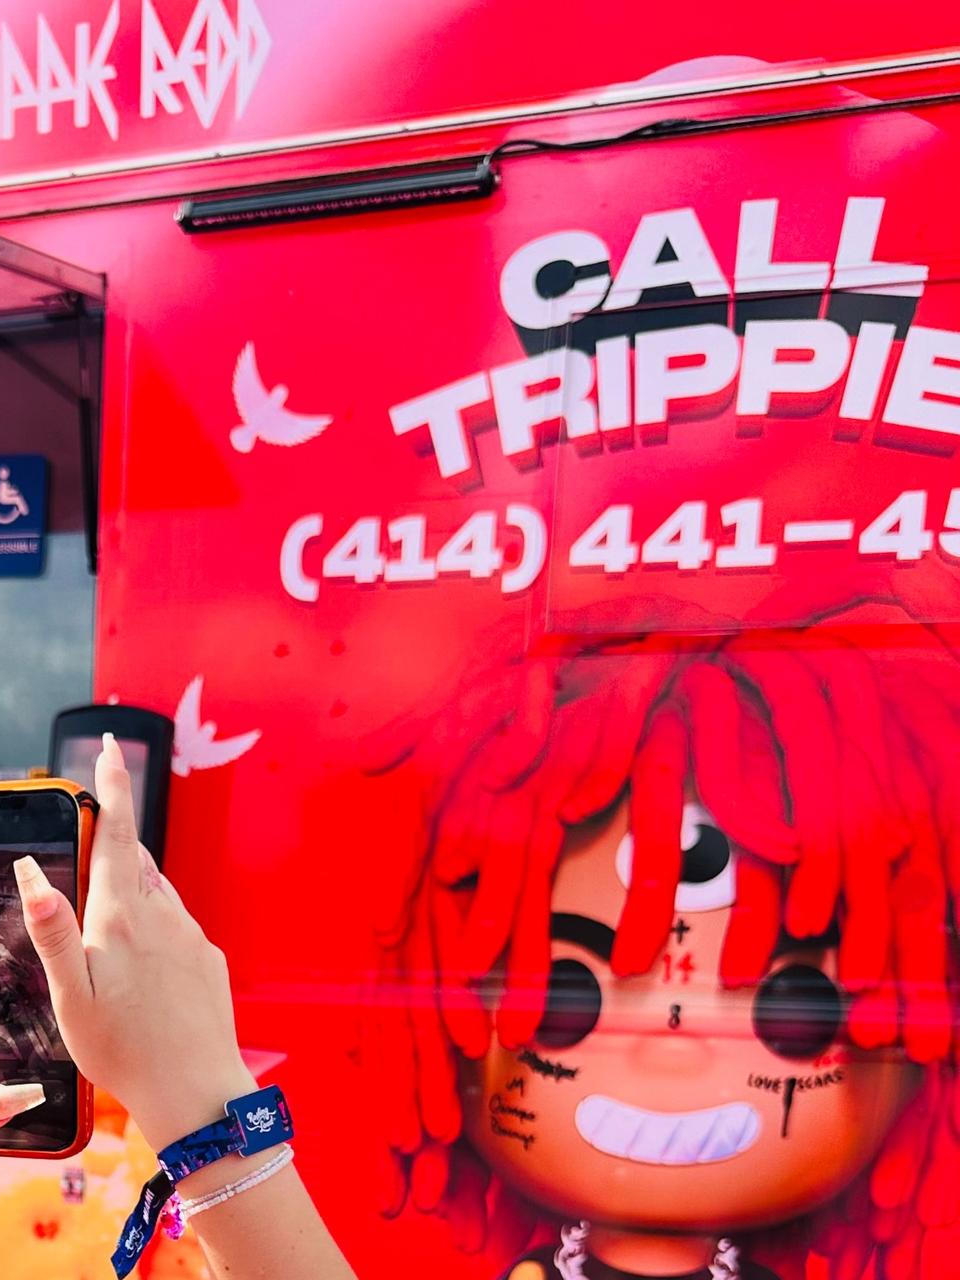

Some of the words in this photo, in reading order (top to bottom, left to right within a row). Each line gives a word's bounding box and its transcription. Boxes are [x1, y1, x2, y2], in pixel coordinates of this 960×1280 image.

[499, 197, 928, 330] CALL
[388, 320, 960, 479] TRIPPIE
[279, 504, 548, 603] (414)
